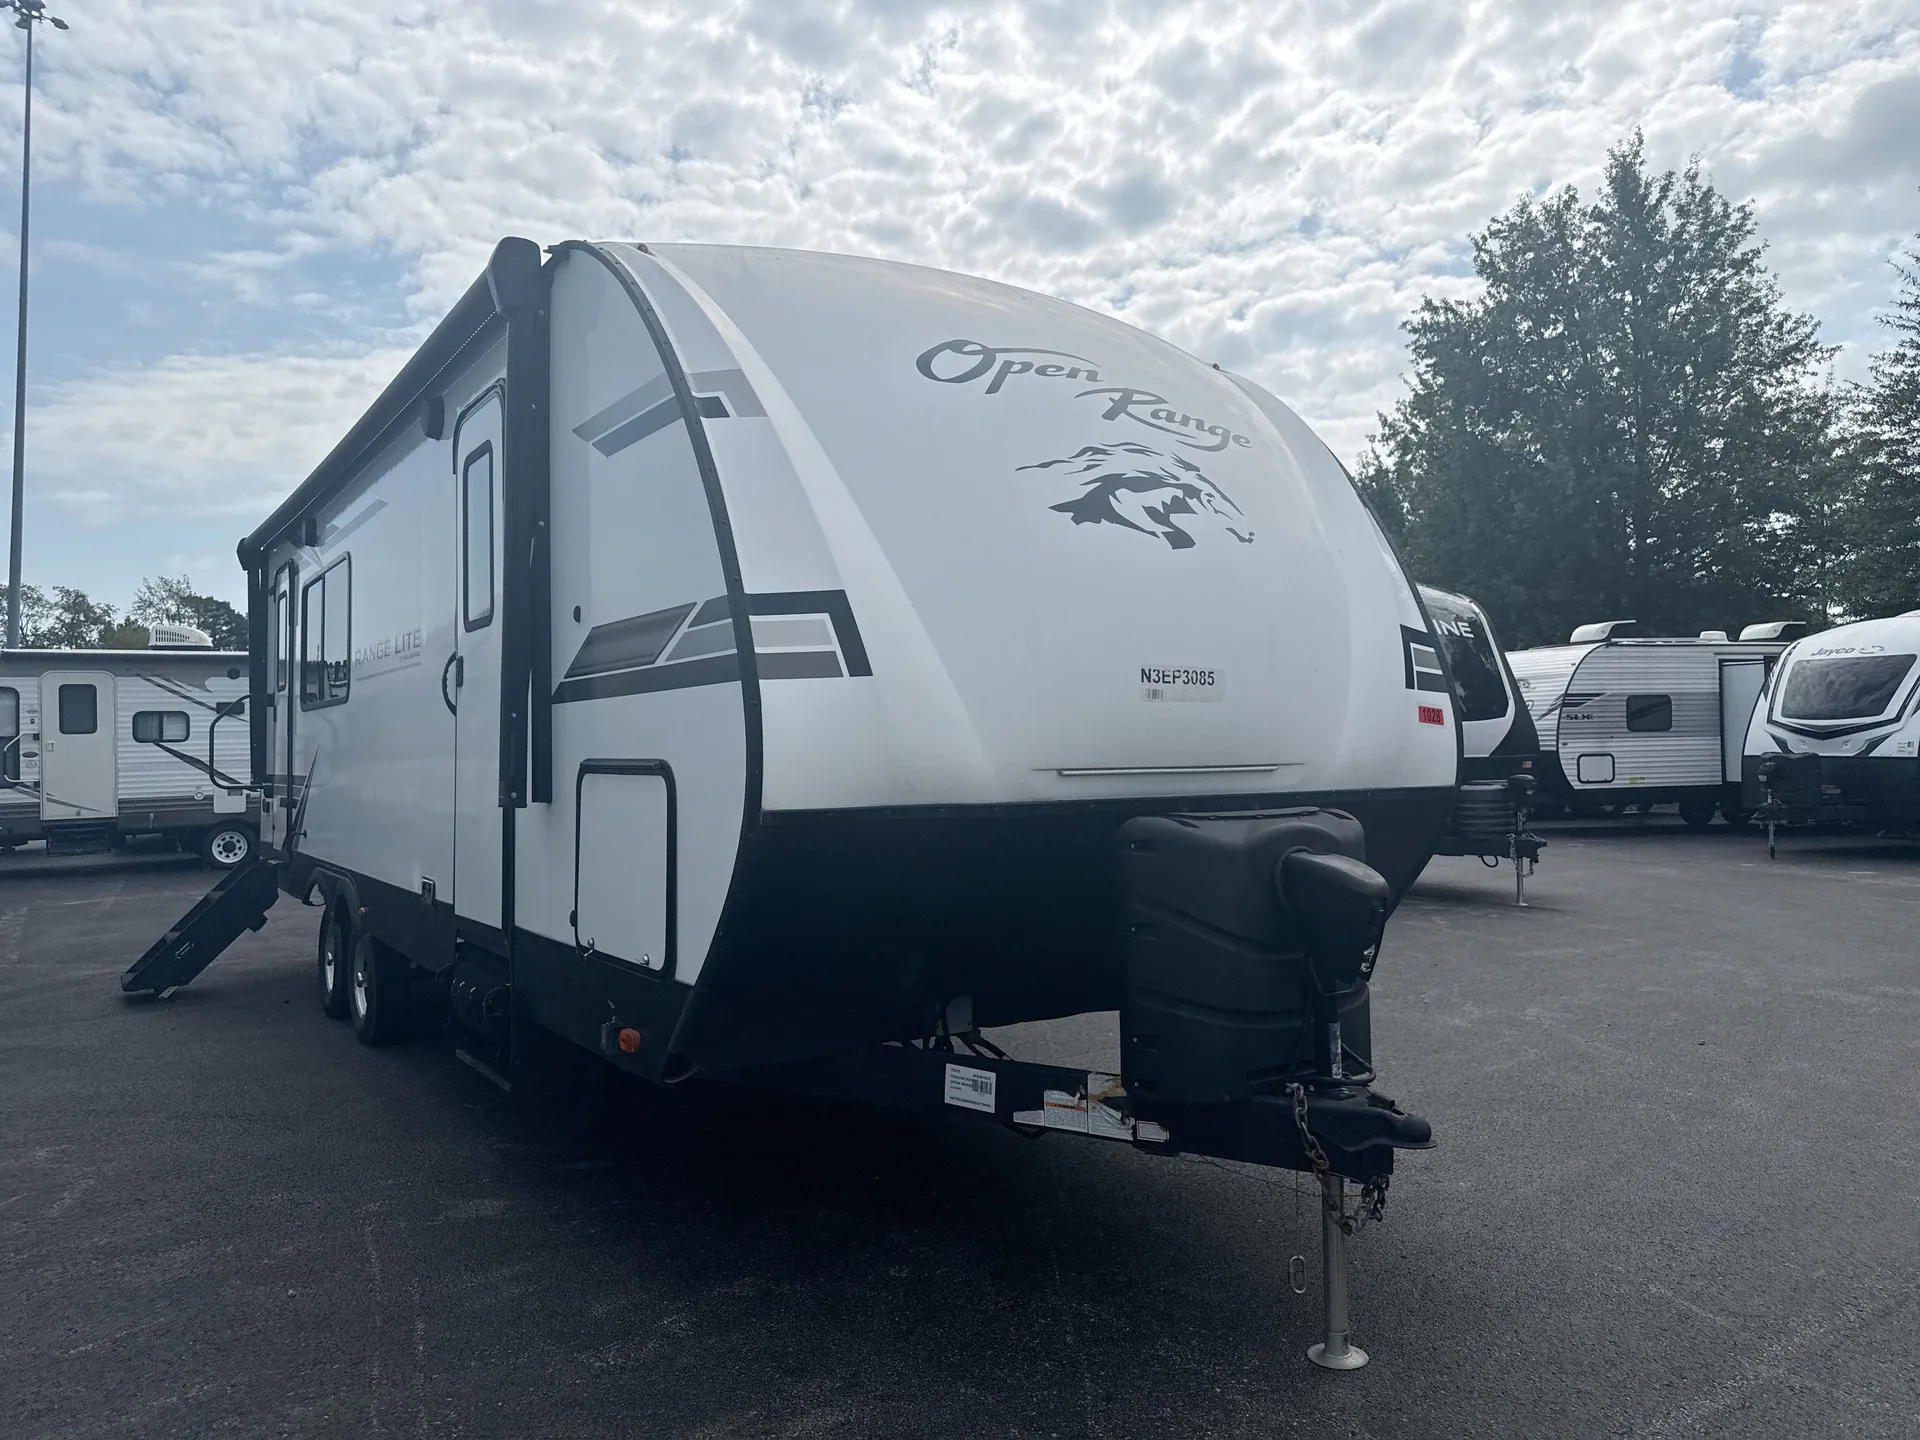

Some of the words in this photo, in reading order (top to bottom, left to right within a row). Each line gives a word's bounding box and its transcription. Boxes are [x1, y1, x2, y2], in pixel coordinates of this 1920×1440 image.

[916, 339, 1103, 394] Open
[1075, 388, 1252, 452] Range
[355, 640, 390, 666] RANGE
[394, 629, 421, 654] LITE
[1810, 647, 1856, 657] Jayco
[1422, 707, 1442, 723] 1028
